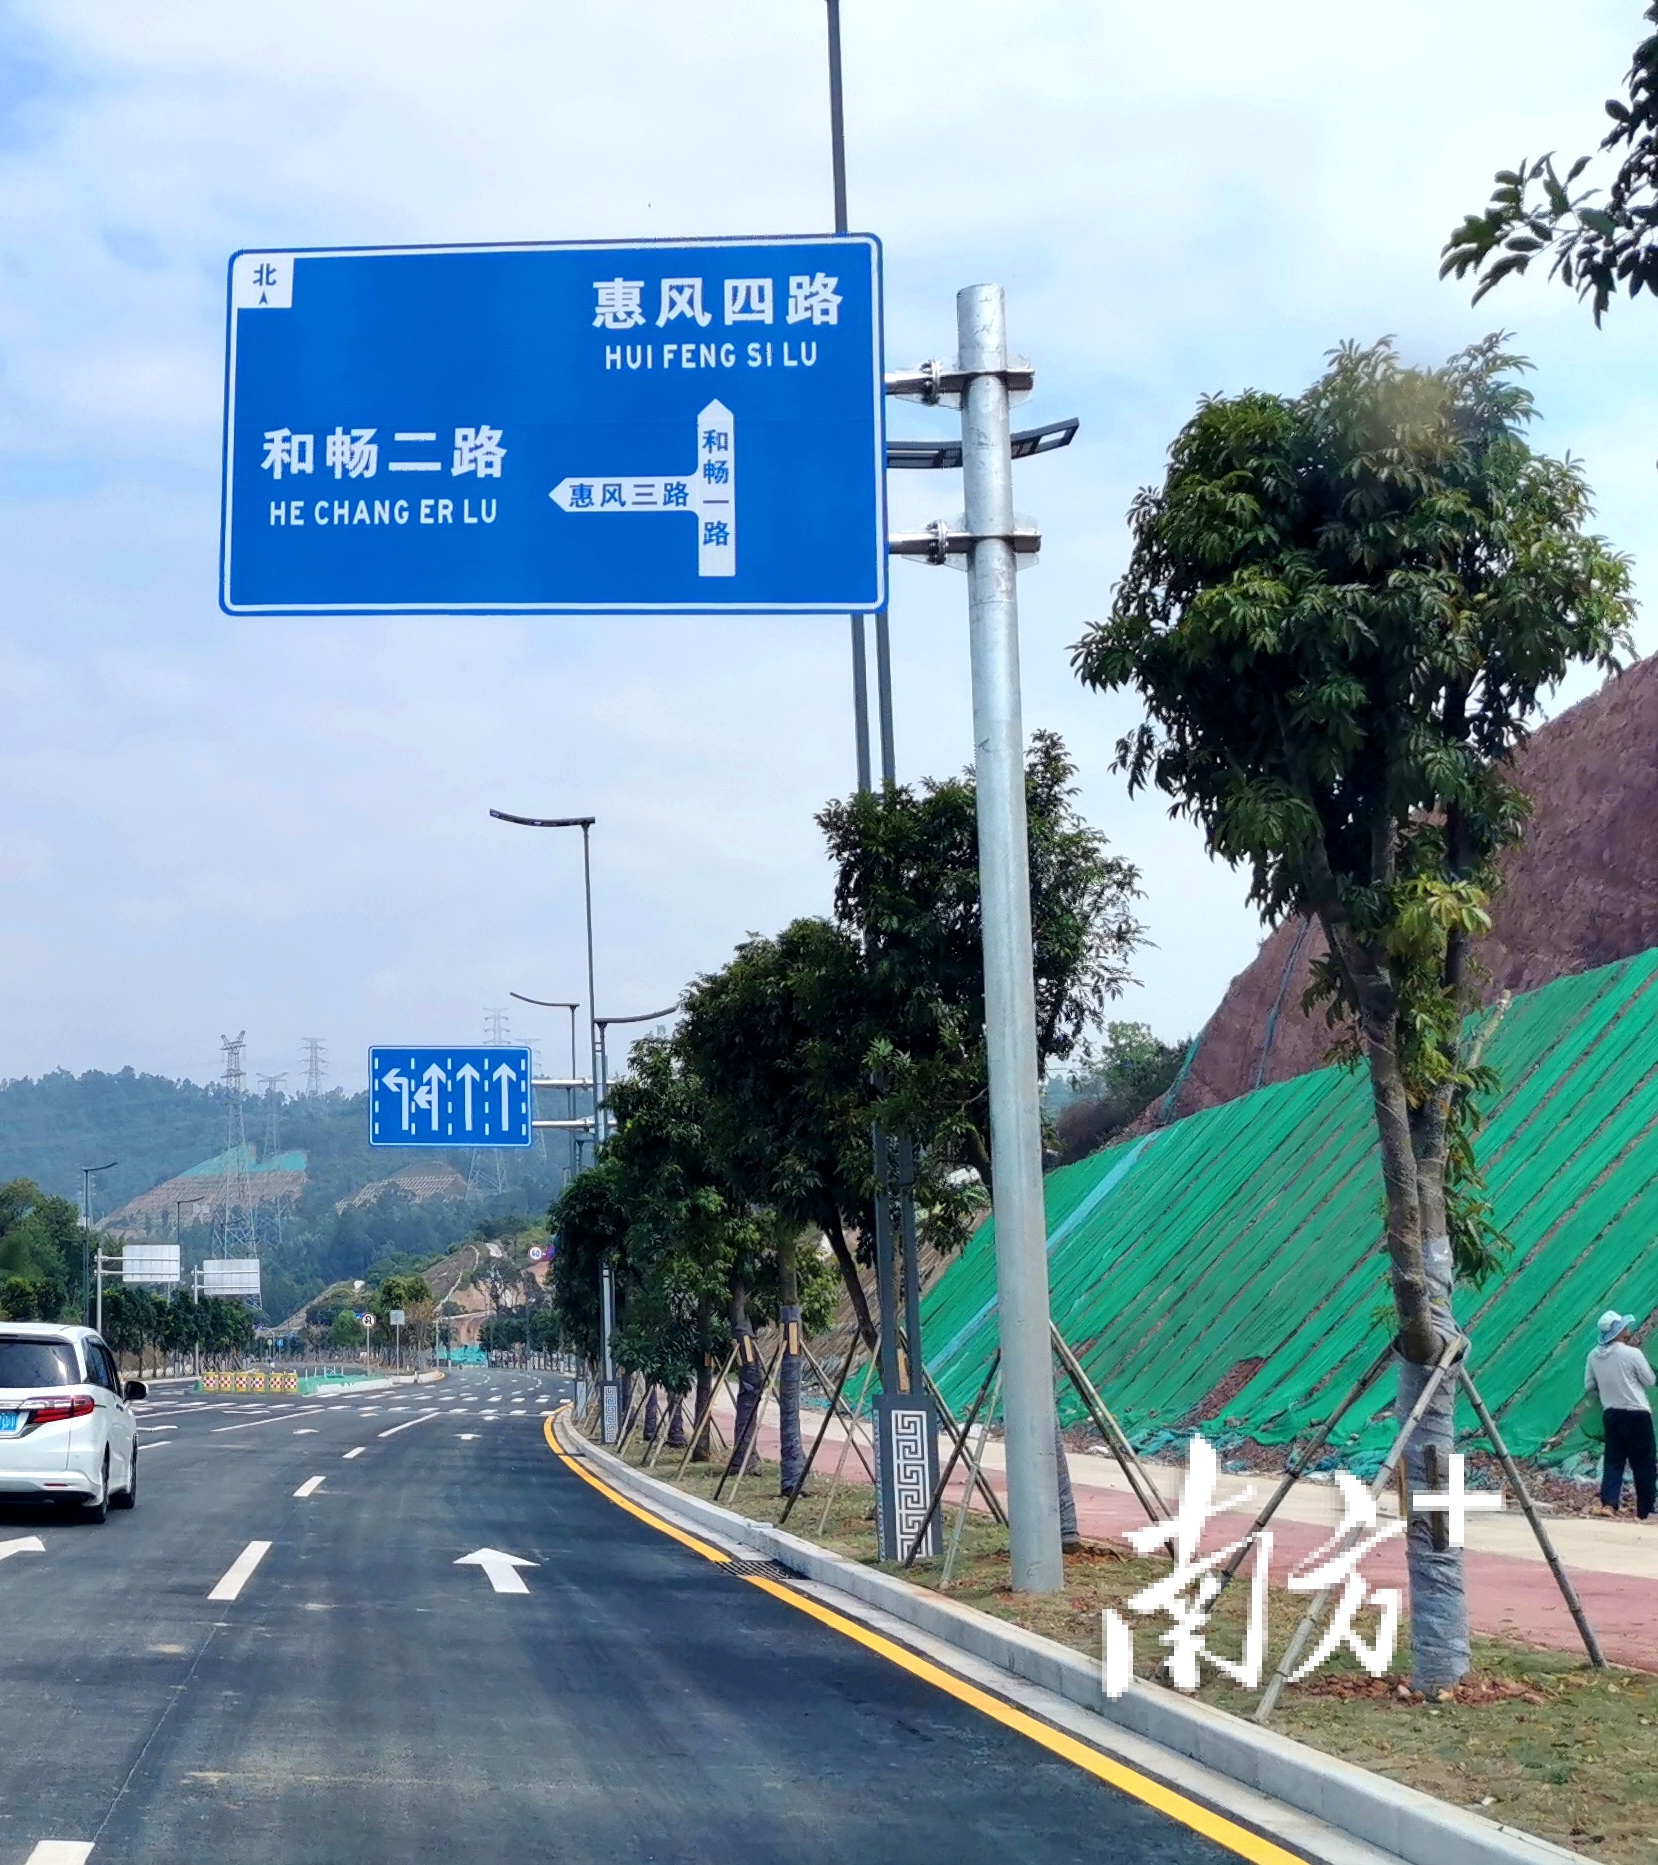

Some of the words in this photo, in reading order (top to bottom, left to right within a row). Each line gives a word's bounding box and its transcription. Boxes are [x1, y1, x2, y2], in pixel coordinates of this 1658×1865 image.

[252, 262, 278, 287] 北
[592, 272, 844, 330] 惠风四路
[605, 344, 653, 370] HUI
[663, 342, 737, 369] FENG
[746, 341, 774, 368] SI
[783, 340, 818, 367] LU
[260, 424, 508, 480] 和畅二路
[568, 480, 690, 509] 惠风三路
[701, 428, 731, 547] 和畅一路
[269, 500, 305, 526] HE
[314, 499, 410, 526] CHANG
[419, 498, 454, 525] ER
[463, 497, 498, 524] LU
